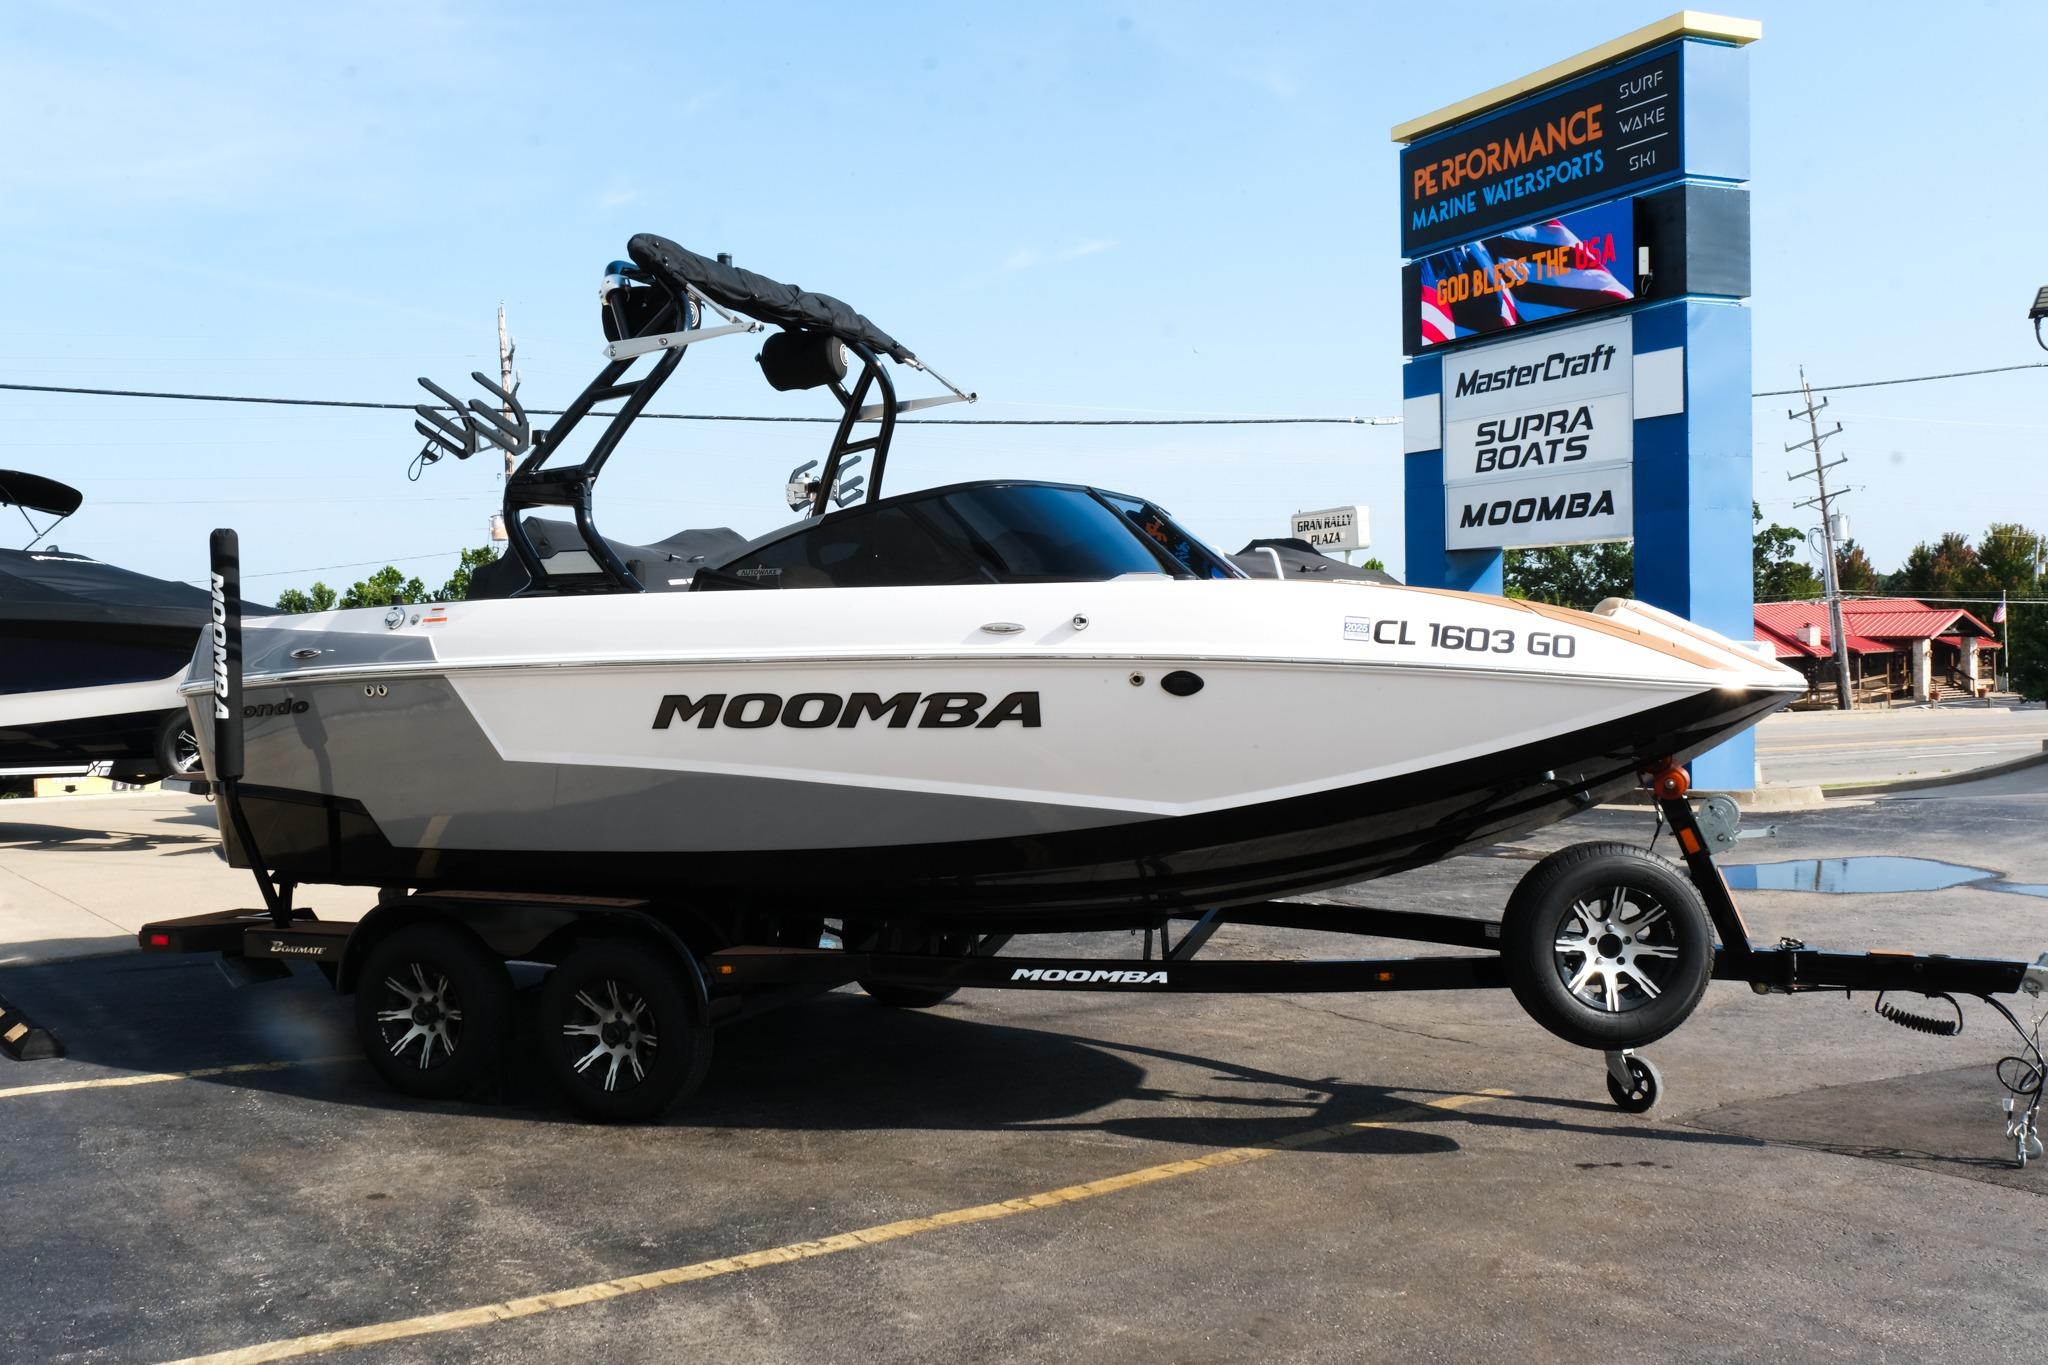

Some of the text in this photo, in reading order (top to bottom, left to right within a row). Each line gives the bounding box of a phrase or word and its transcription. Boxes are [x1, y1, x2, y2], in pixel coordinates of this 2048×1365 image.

[1619, 70, 1664, 99] SURF
[1619, 106, 1665, 134] WAKE
[1414, 103, 1603, 200] PERFORMANCE
[1629, 149, 1656, 172] SKI
[1412, 149, 1604, 232] MARINE WATERSPORTS
[1436, 233, 1616, 306] GOD BLESS THE USA
[1455, 344, 1616, 398] MasterCraft
[1475, 405, 1594, 447] SUPRA
[1475, 434, 1590, 473] BOATS
[1297, 514, 1352, 533] GRAN RALLY
[1460, 490, 1615, 529] MOOMBA
[1311, 531, 1341, 546] PLAZA
[211, 571, 230, 720] MOOMBA
[1345, 623, 1368, 633] 2025
[1373, 619, 1576, 659] CL 1603 GO
[241, 697, 310, 719] ondo
[651, 691, 1042, 730] MOOMBA
[1010, 968, 1169, 984] MOOMBA
